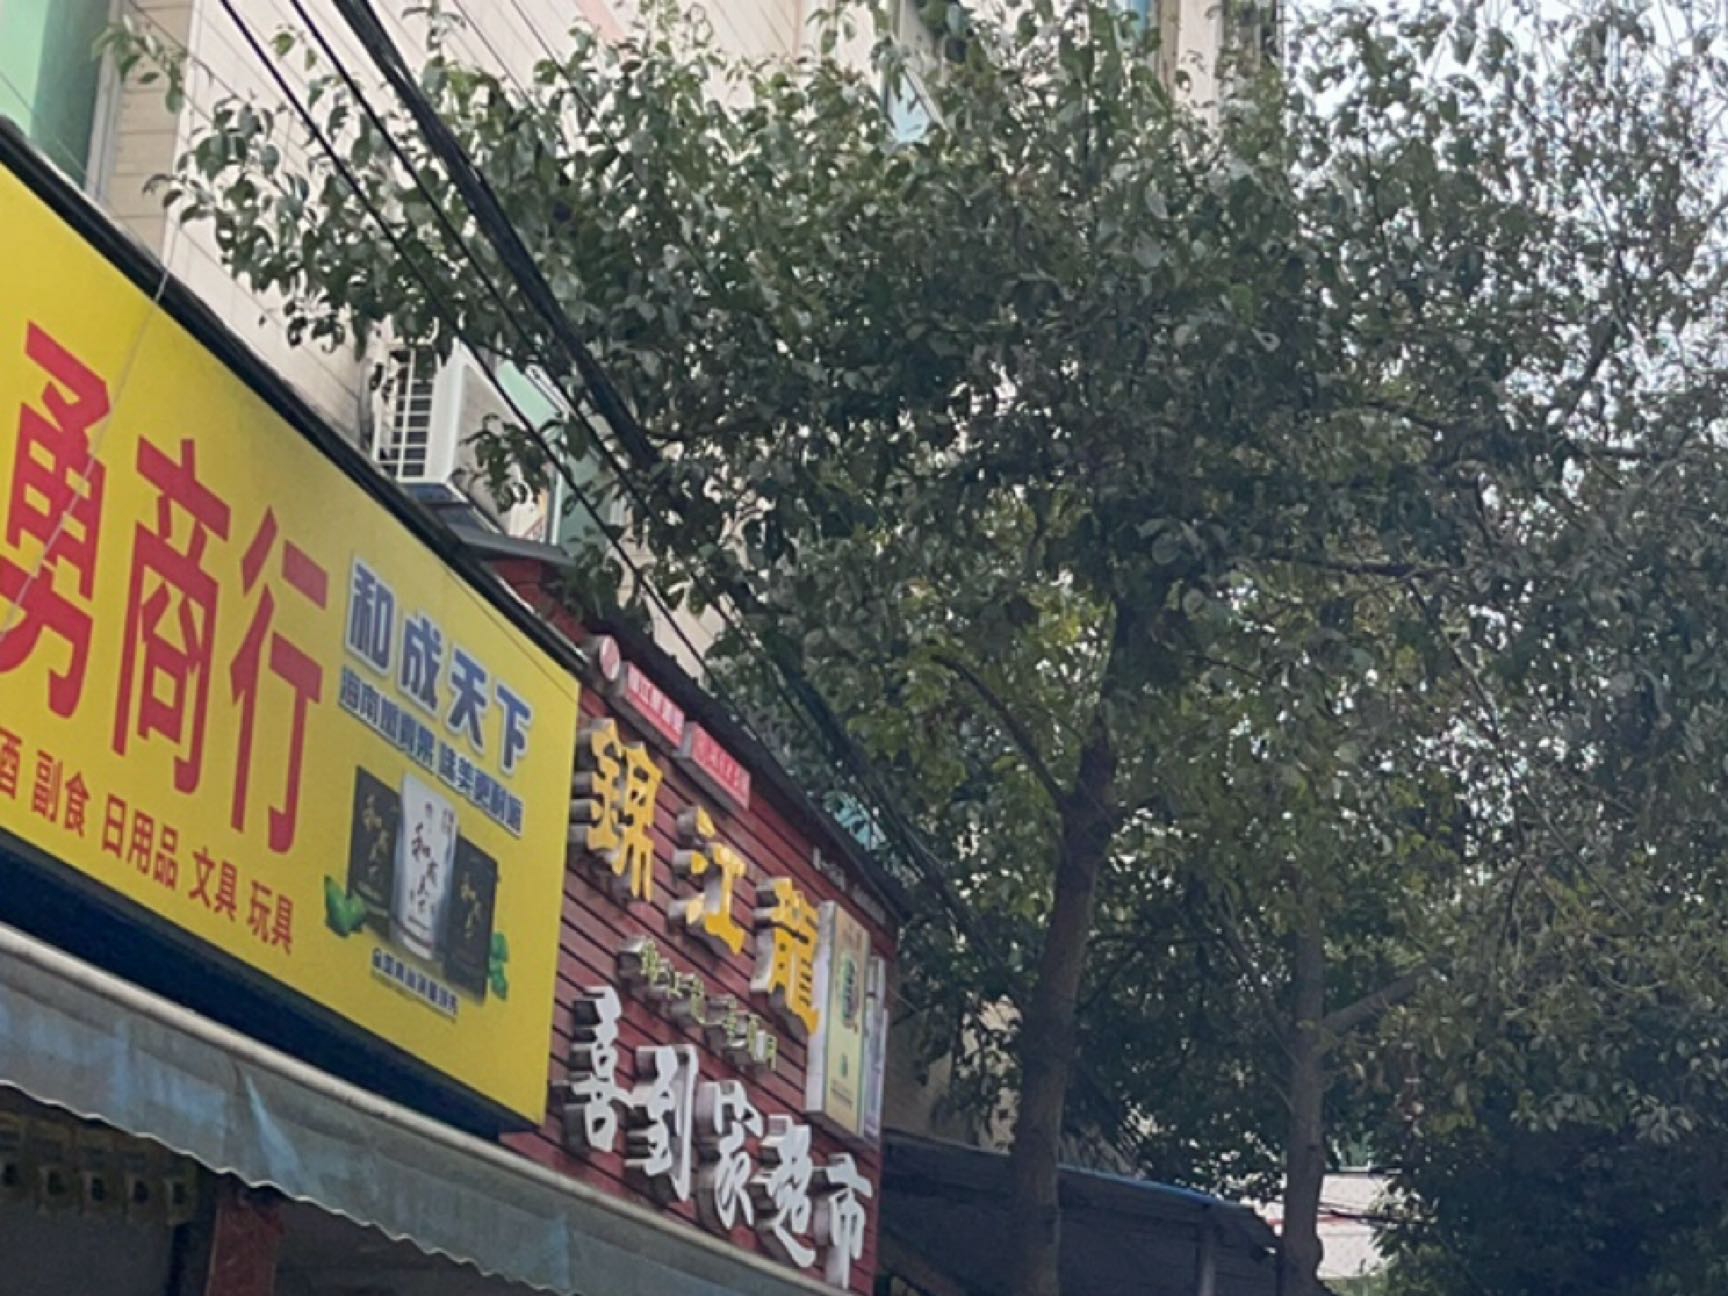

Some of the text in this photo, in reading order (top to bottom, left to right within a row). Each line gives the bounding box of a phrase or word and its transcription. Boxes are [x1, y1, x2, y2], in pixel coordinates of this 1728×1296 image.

[348, 559, 533, 773] 和成天下
[31, 749, 90, 838] 副食
[101, 792, 178, 890] 日用品
[188, 845, 237, 922] 文具
[246, 879, 293, 955] 玩具
